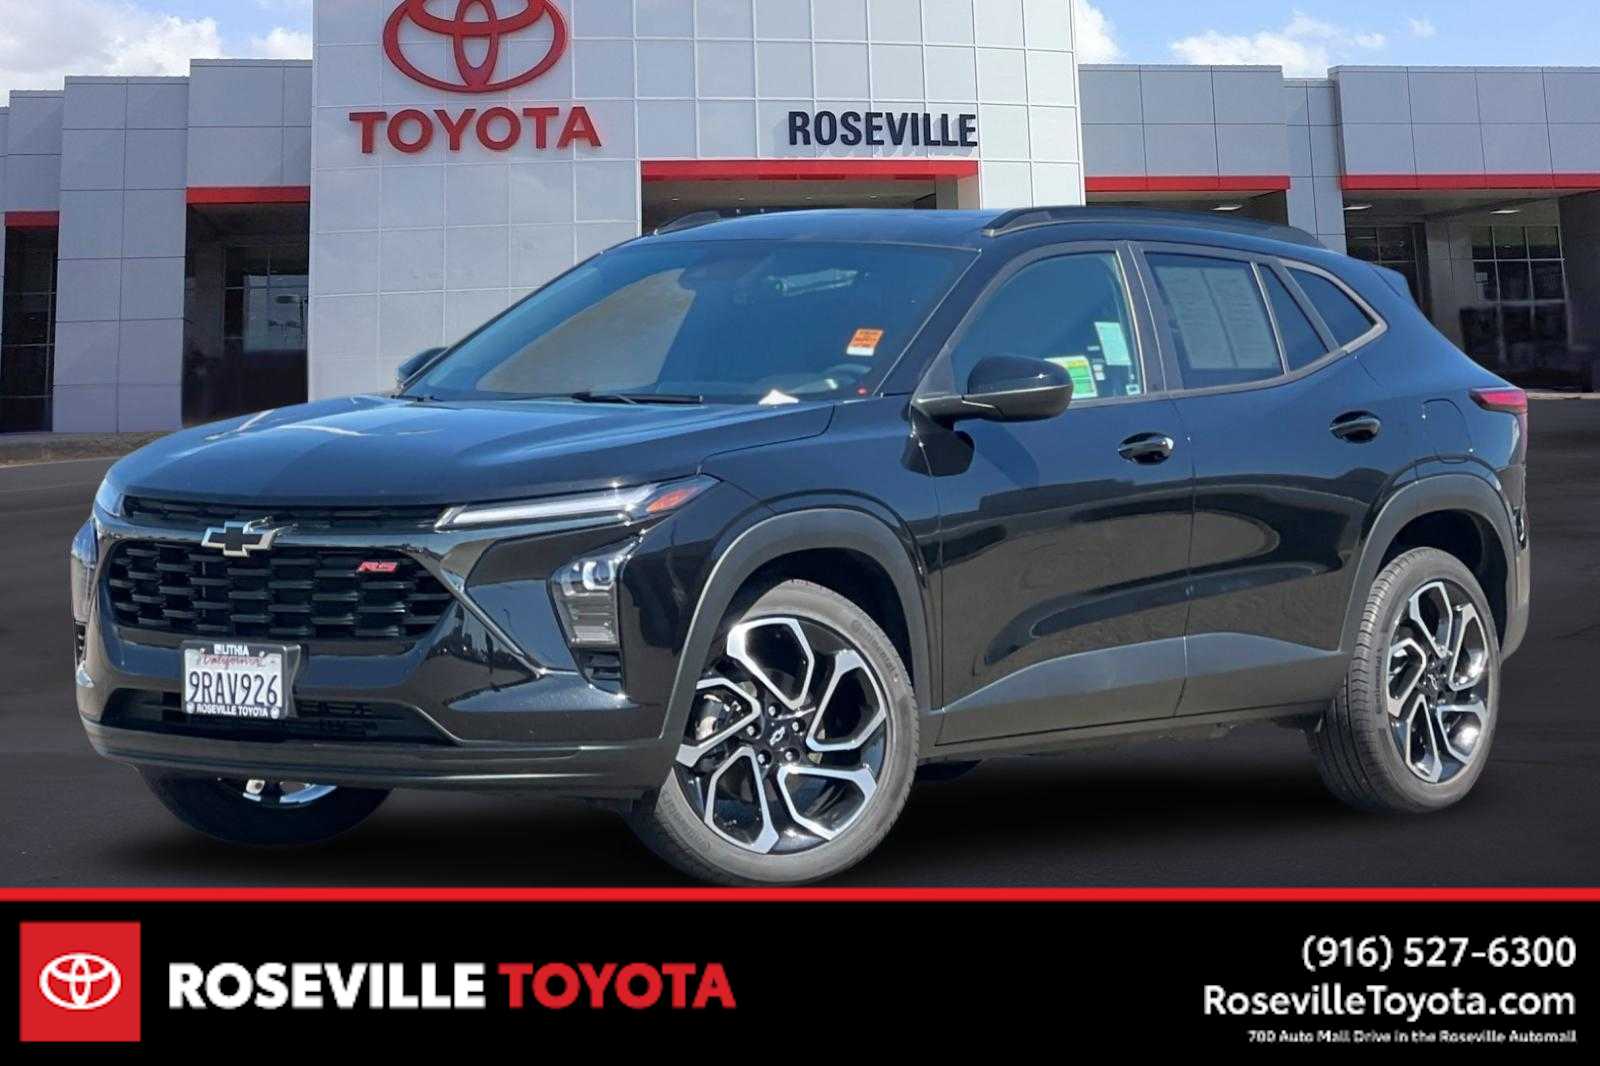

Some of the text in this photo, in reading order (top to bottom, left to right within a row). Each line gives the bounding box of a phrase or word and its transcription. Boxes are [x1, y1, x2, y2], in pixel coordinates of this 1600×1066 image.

[349, 106, 602, 154] TOYOTA
[788, 110, 978, 147] ROSEVILLE
[189, 670, 278, 707] 9RAV926
[196, 703, 269, 718] ROSEVILLE TOYOTA
